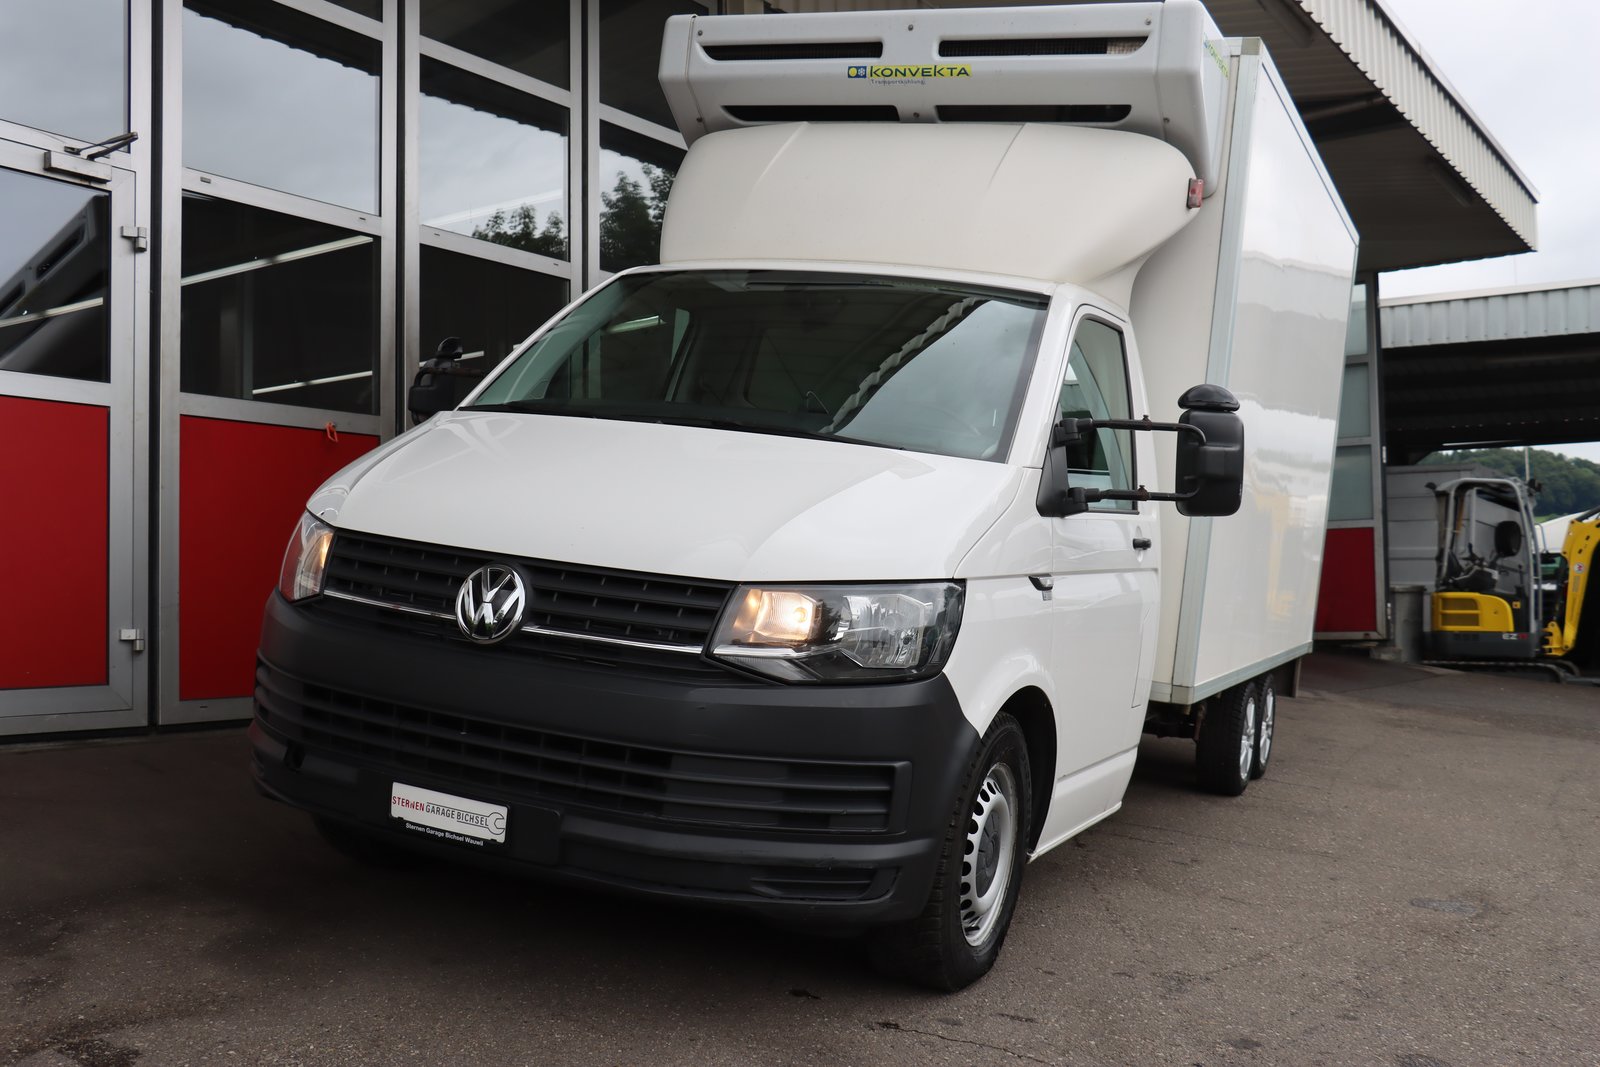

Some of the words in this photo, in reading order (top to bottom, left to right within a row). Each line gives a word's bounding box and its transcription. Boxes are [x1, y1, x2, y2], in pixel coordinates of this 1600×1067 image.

[869, 64, 970, 78] KONVEKTA
[392, 795, 425, 812] STERNEN
[425, 804, 456, 820] GARAGE
[456, 811, 489, 827] BICHSEL
[405, 822, 426, 832] Sternen
[426, 827, 445, 838] Garage
[445, 832, 465, 842] Bichsel
[465, 837, 484, 847] Wauwil
